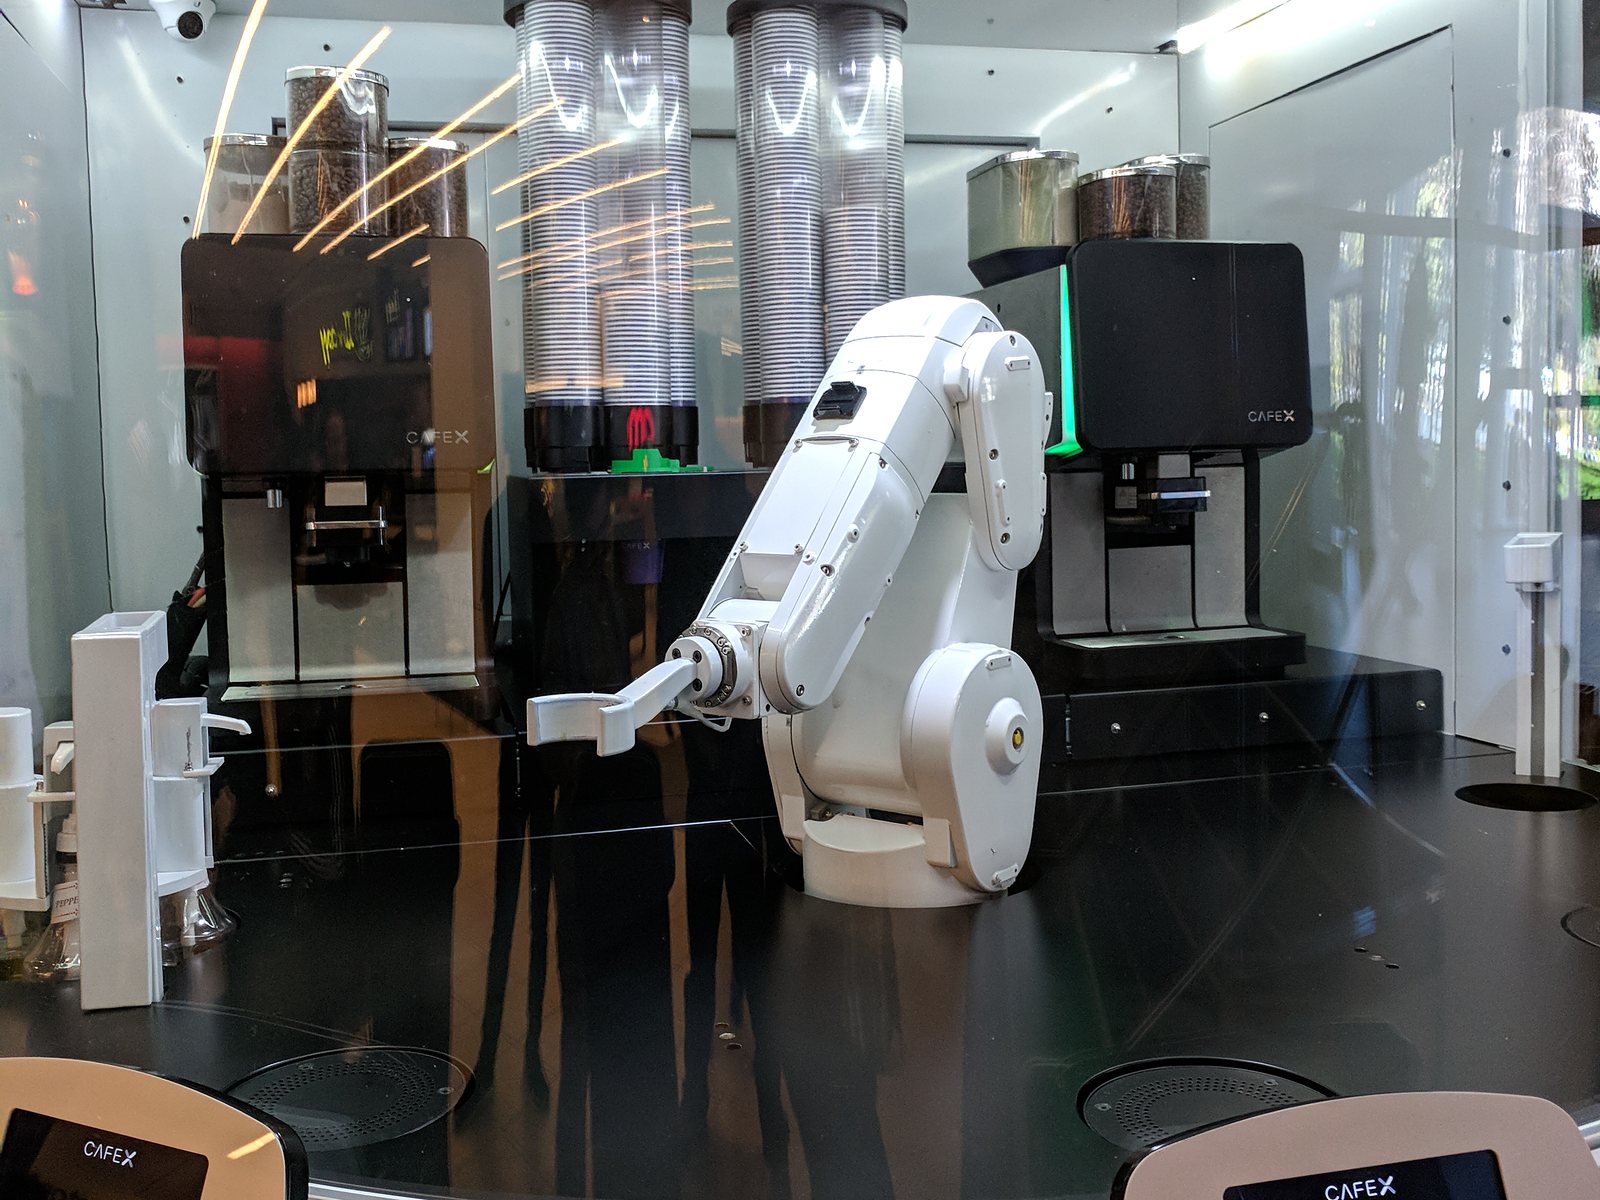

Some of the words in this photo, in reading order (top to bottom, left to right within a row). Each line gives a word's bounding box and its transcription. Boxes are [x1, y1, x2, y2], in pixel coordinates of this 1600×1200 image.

[1248, 410, 1295, 422] CAFEX
[83, 1141, 137, 1168] CAFEX
[1325, 1175, 1396, 1200] CAFEX
